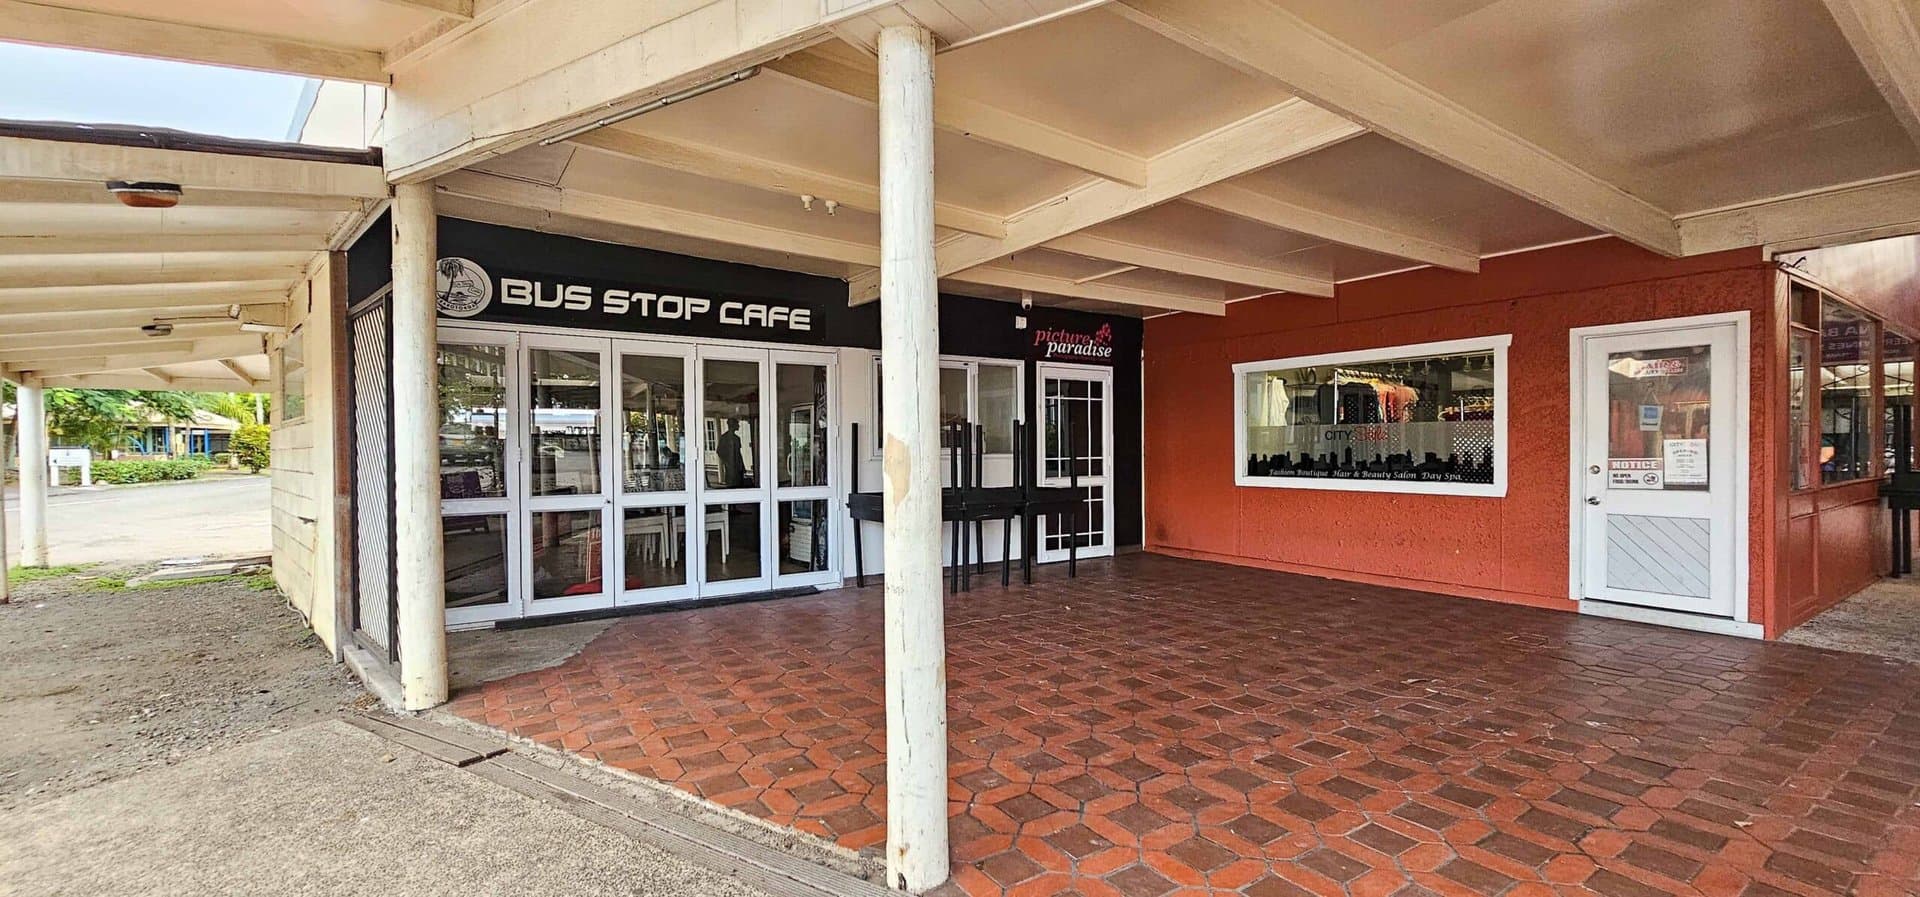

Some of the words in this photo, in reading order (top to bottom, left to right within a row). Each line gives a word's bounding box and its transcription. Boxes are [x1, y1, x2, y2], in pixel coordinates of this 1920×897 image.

[501, 278, 592, 311] BUS
[603, 290, 711, 320] STOP
[719, 301, 811, 331] CAFE
[1034, 328, 1090, 345] picture
[1045, 340, 1112, 357] paradise
[1324, 430, 1352, 441] CITY
[1612, 460, 1658, 469] NOTICE
[1297, 468, 1328, 479] Boutique
[1332, 469, 1352, 478] Hair
[1353, 470, 1360, 478] &
[1361, 470, 1392, 480] Beauty
[1393, 470, 1417, 480] Salon
[1422, 471, 1442, 481] Day
